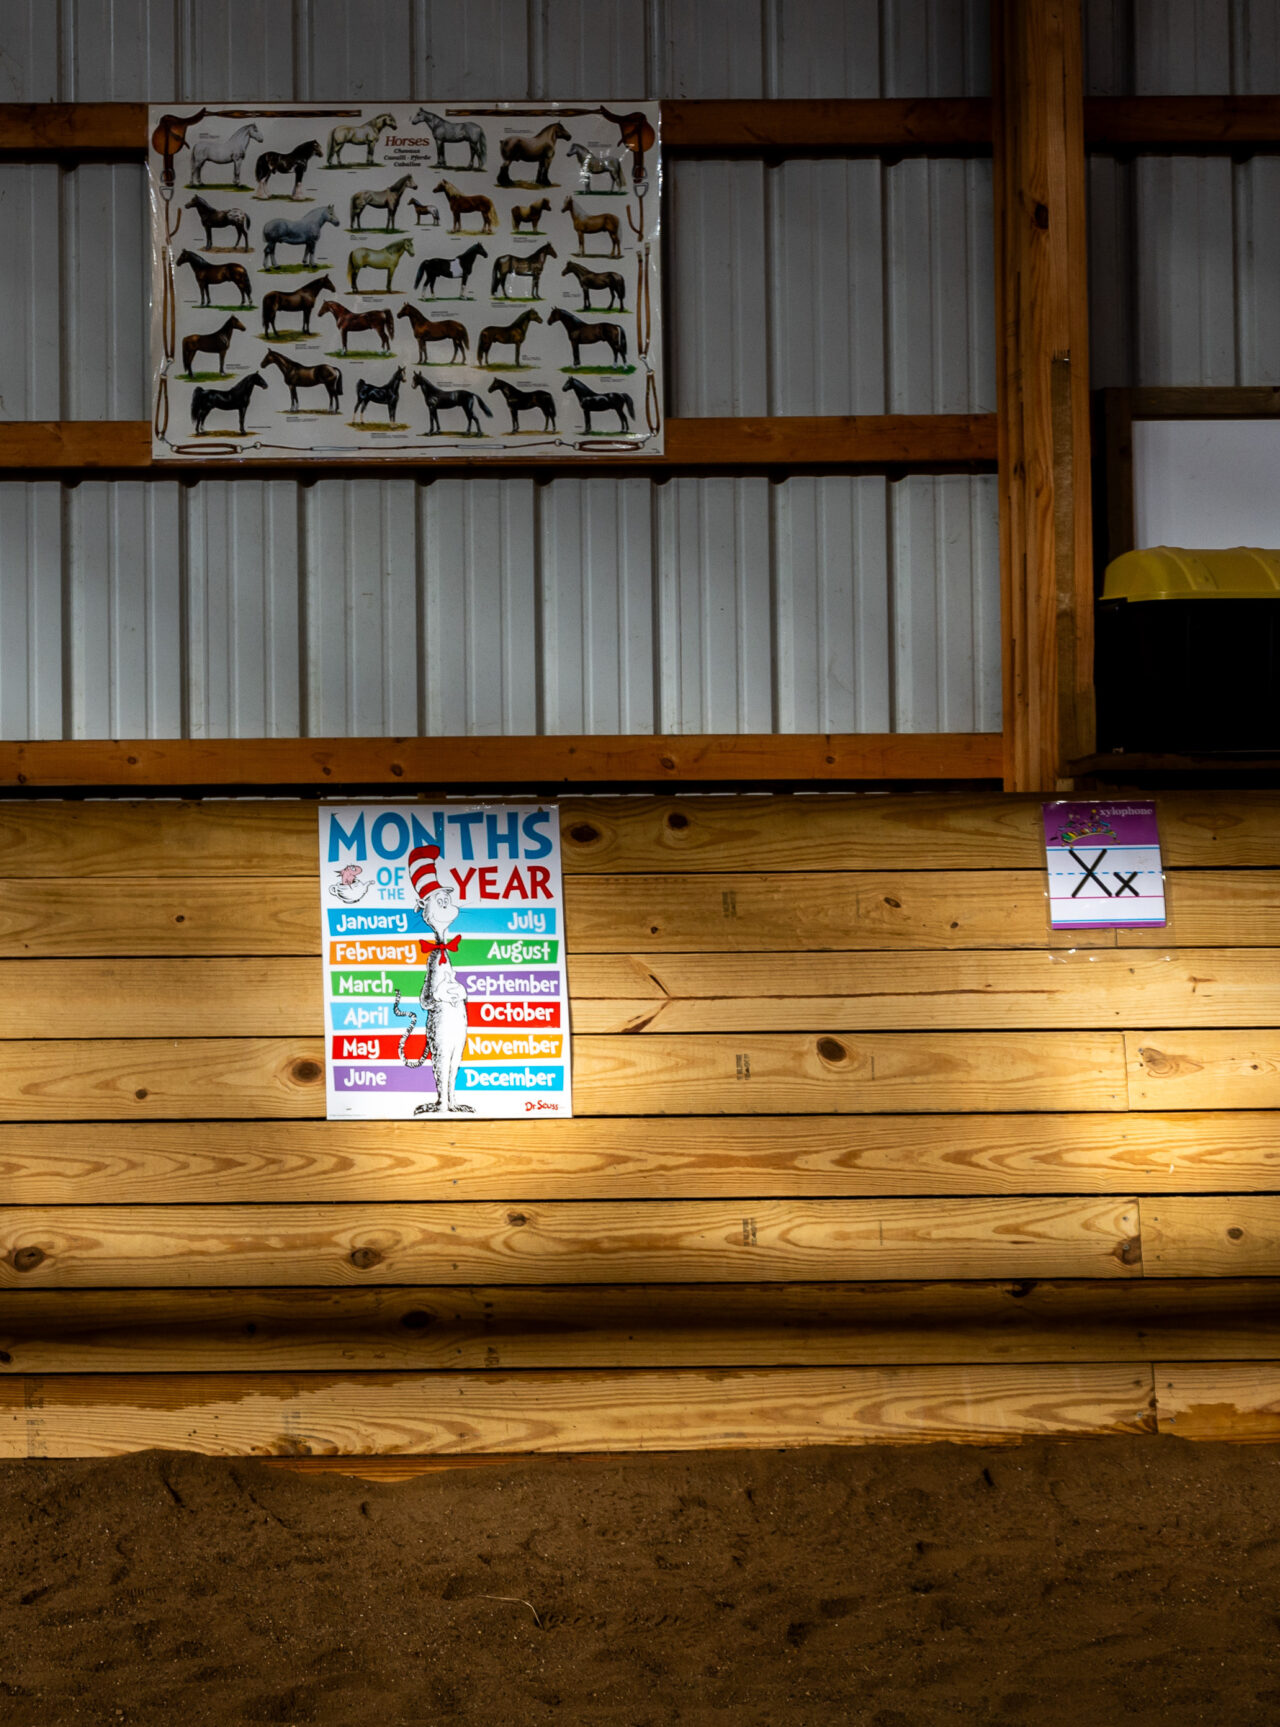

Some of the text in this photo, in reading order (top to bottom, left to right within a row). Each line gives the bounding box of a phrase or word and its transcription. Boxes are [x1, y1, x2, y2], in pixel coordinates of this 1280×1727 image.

[385, 136, 430, 146] Horses
[1099, 806, 1153, 818] xylophone
[328, 811, 553, 863] MONTHS
[376, 866, 406, 887] OF
[449, 865, 554, 900] YEAR
[377, 888, 405, 901] THE
[336, 911, 409, 933] January
[507, 910, 546, 932] July
[335, 943, 417, 963] February
[487, 940, 551, 963] August
[338, 971, 394, 994] March
[466, 974, 559, 995] September
[343, 1006, 389, 1028] April
[480, 1002, 554, 1023] October
[342, 1037, 381, 1059] May
[467, 1036, 560, 1056] November
[344, 1068, 387, 1087] June
[465, 1068, 556, 1088] December
